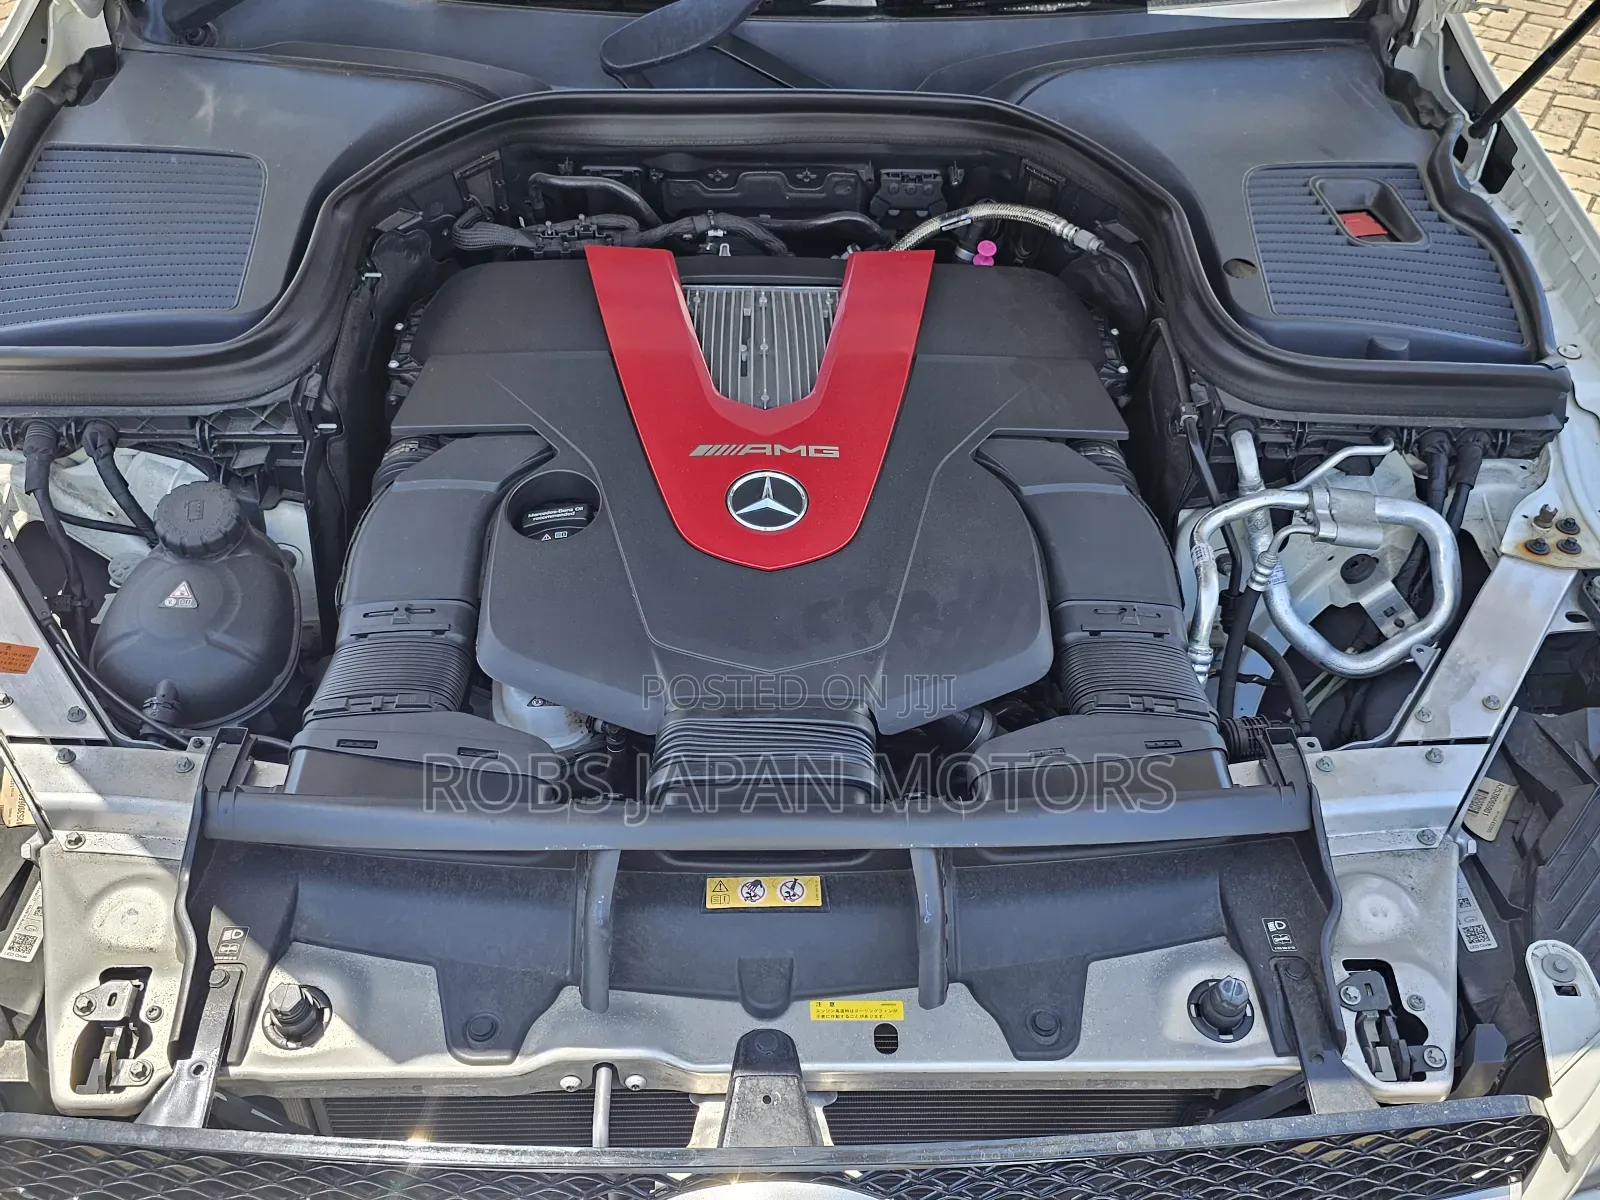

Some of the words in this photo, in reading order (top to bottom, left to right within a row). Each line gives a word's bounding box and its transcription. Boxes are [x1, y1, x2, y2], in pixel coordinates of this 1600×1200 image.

[737, 443, 840, 458] AMG
[528, 508, 573, 518] Mercedes-Benz
[533, 511, 575, 521] recommended
